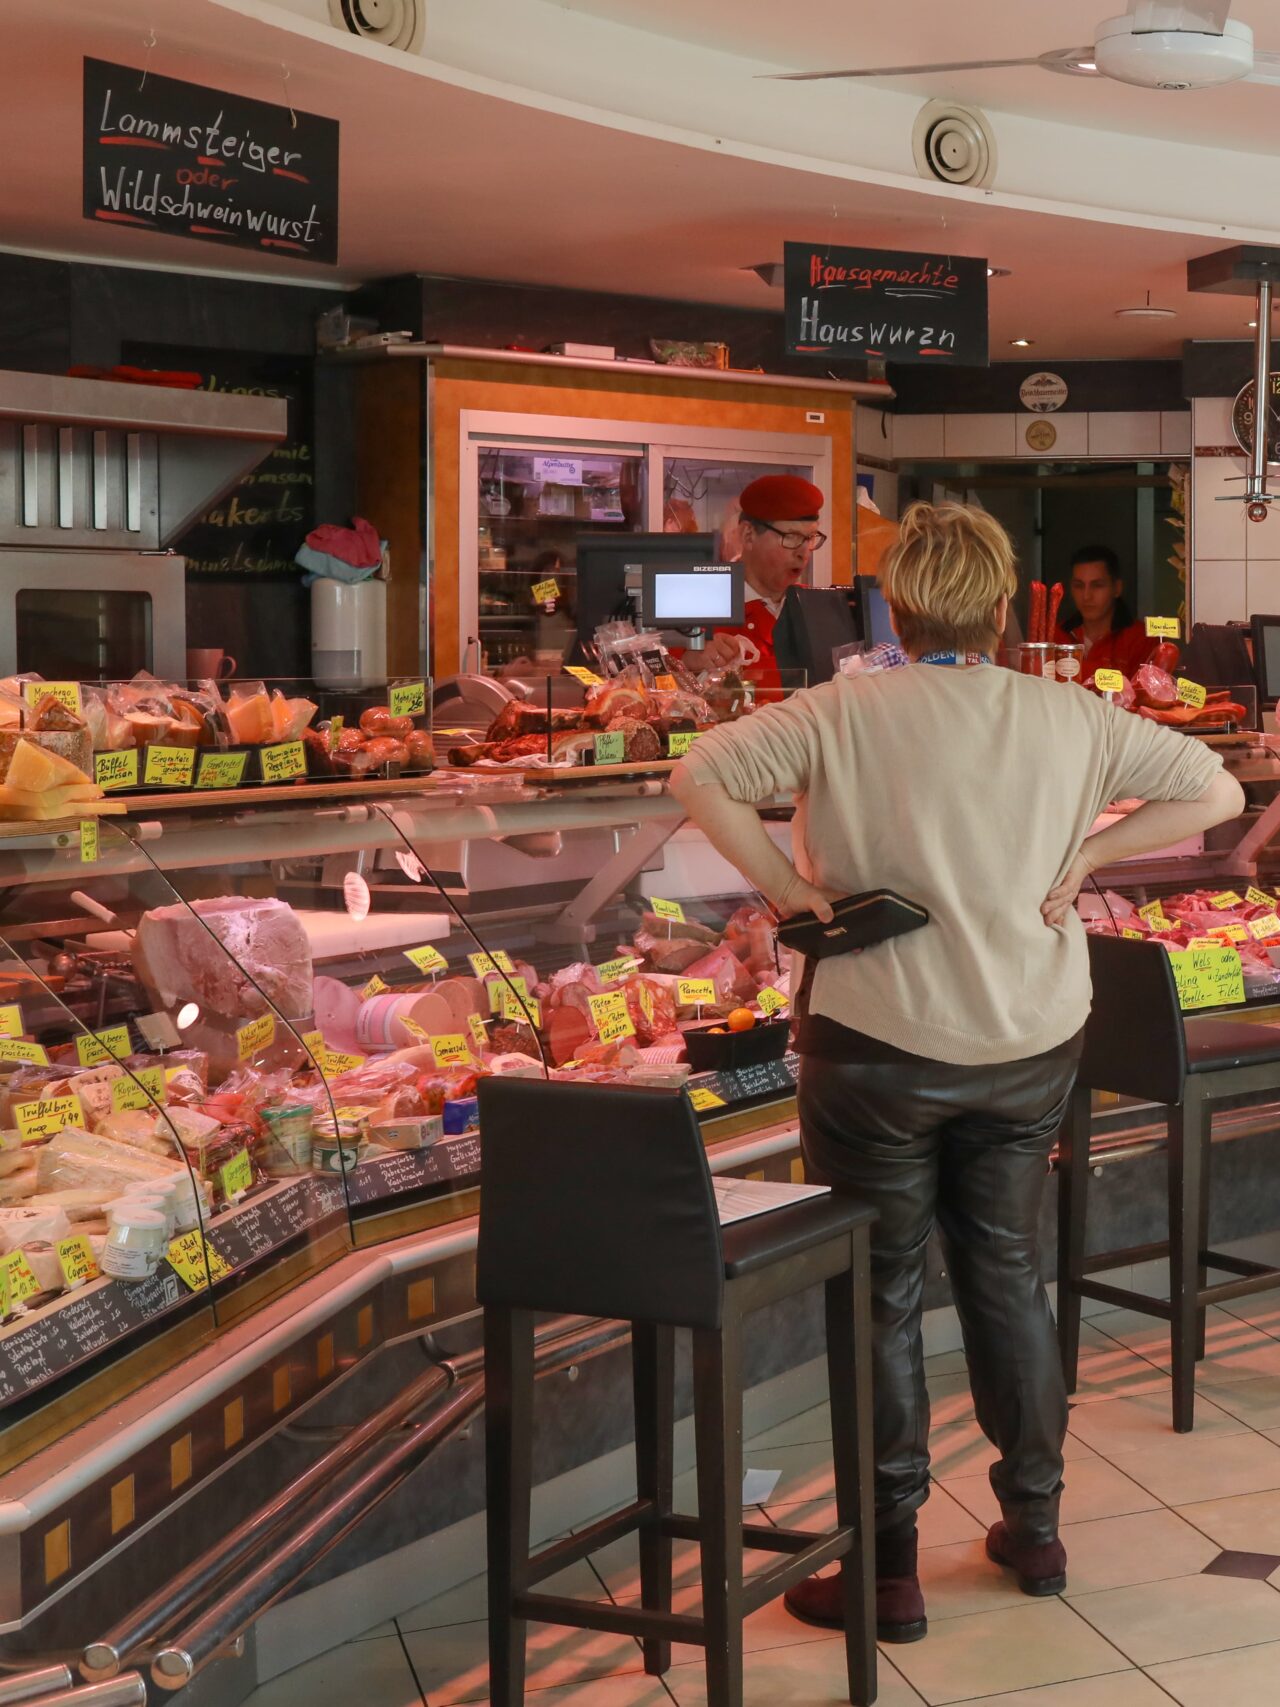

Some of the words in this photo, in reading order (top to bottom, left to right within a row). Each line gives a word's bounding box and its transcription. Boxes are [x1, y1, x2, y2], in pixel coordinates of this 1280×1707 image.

[100, 89, 302, 173] Lammsteiger
[100, 166, 321, 243] Wildschweinwurst
[810, 254, 960, 288] Hausgemachte
[1243, 411, 1253, 425] 9
[97, 756, 129, 774] Büffel
[1192, 952, 1211, 969] Wels
[1217, 984, 1240, 997] Filet
[18, 1100, 73, 1118] Trüffelbrie
